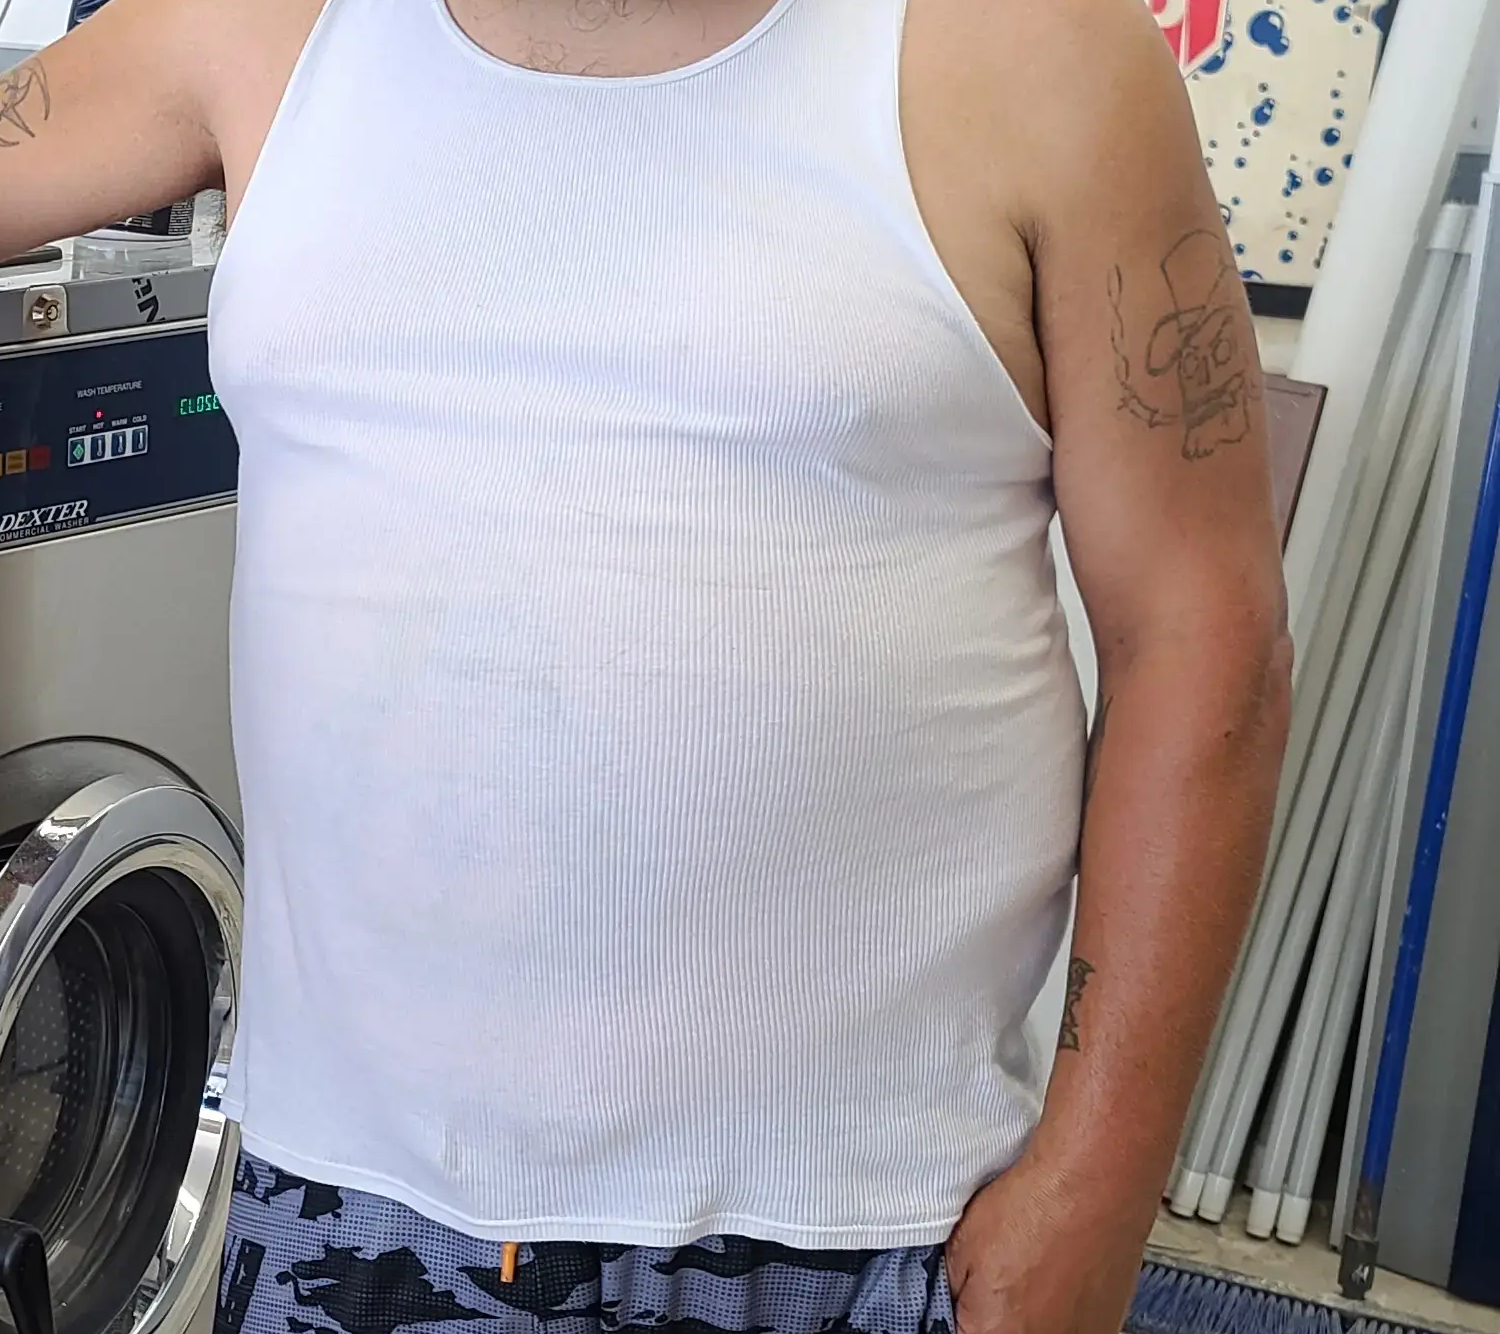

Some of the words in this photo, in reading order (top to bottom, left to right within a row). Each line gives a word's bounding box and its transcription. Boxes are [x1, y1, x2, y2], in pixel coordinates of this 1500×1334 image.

[77, 387, 97, 399] WASH
[97, 380, 143, 396] TEMPERATURE
[68, 425, 87, 434] START
[92, 421, 104, 430] HOT
[111, 418, 128, 427] WARM
[132, 414, 147, 424] COLD
[53, 517, 90, 531] WASHER
